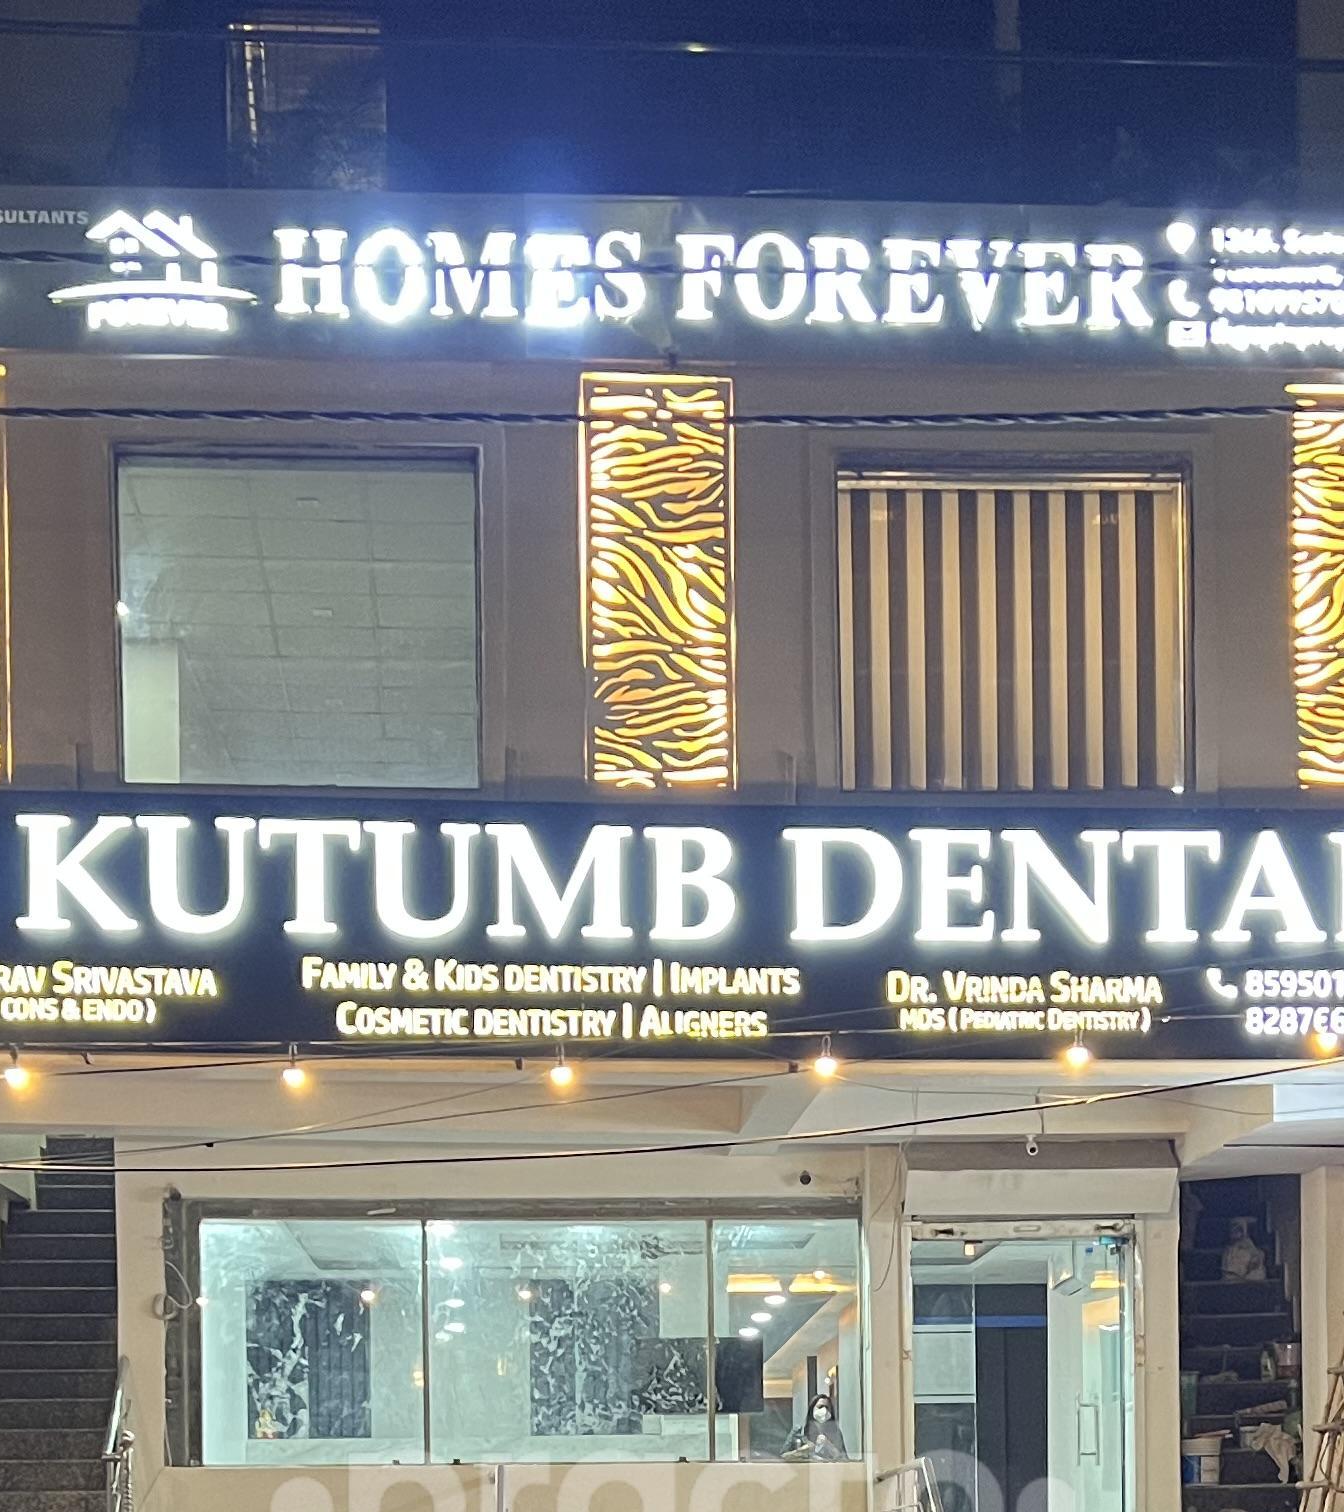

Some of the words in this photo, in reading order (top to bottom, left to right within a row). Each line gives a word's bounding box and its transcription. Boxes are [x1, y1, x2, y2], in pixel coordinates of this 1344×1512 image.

[274, 228, 646, 328] HOMES
[676, 231, 1153, 332] FOREVER
[16, 815, 735, 942] KUTUMB
[52, 960, 218, 997] SRIVASTAVA
[302, 956, 398, 990] FAMILY
[402, 958, 429, 992] &
[434, 958, 499, 992] KIDS
[504, 964, 647, 993] DENTISTRY
[670, 961, 801, 996] IMPLANTS
[886, 970, 938, 1003] DR.
[942, 970, 1046, 1003] VRINDA
[1049, 970, 1163, 1004] SHARMA
[61, 998, 81, 1022] &
[335, 1001, 469, 1036] COSMETIC
[473, 1008, 616, 1037] DENTISTRY
[639, 1004, 768, 1038] ALIGNERS
[899, 1007, 946, 1031] MDS
